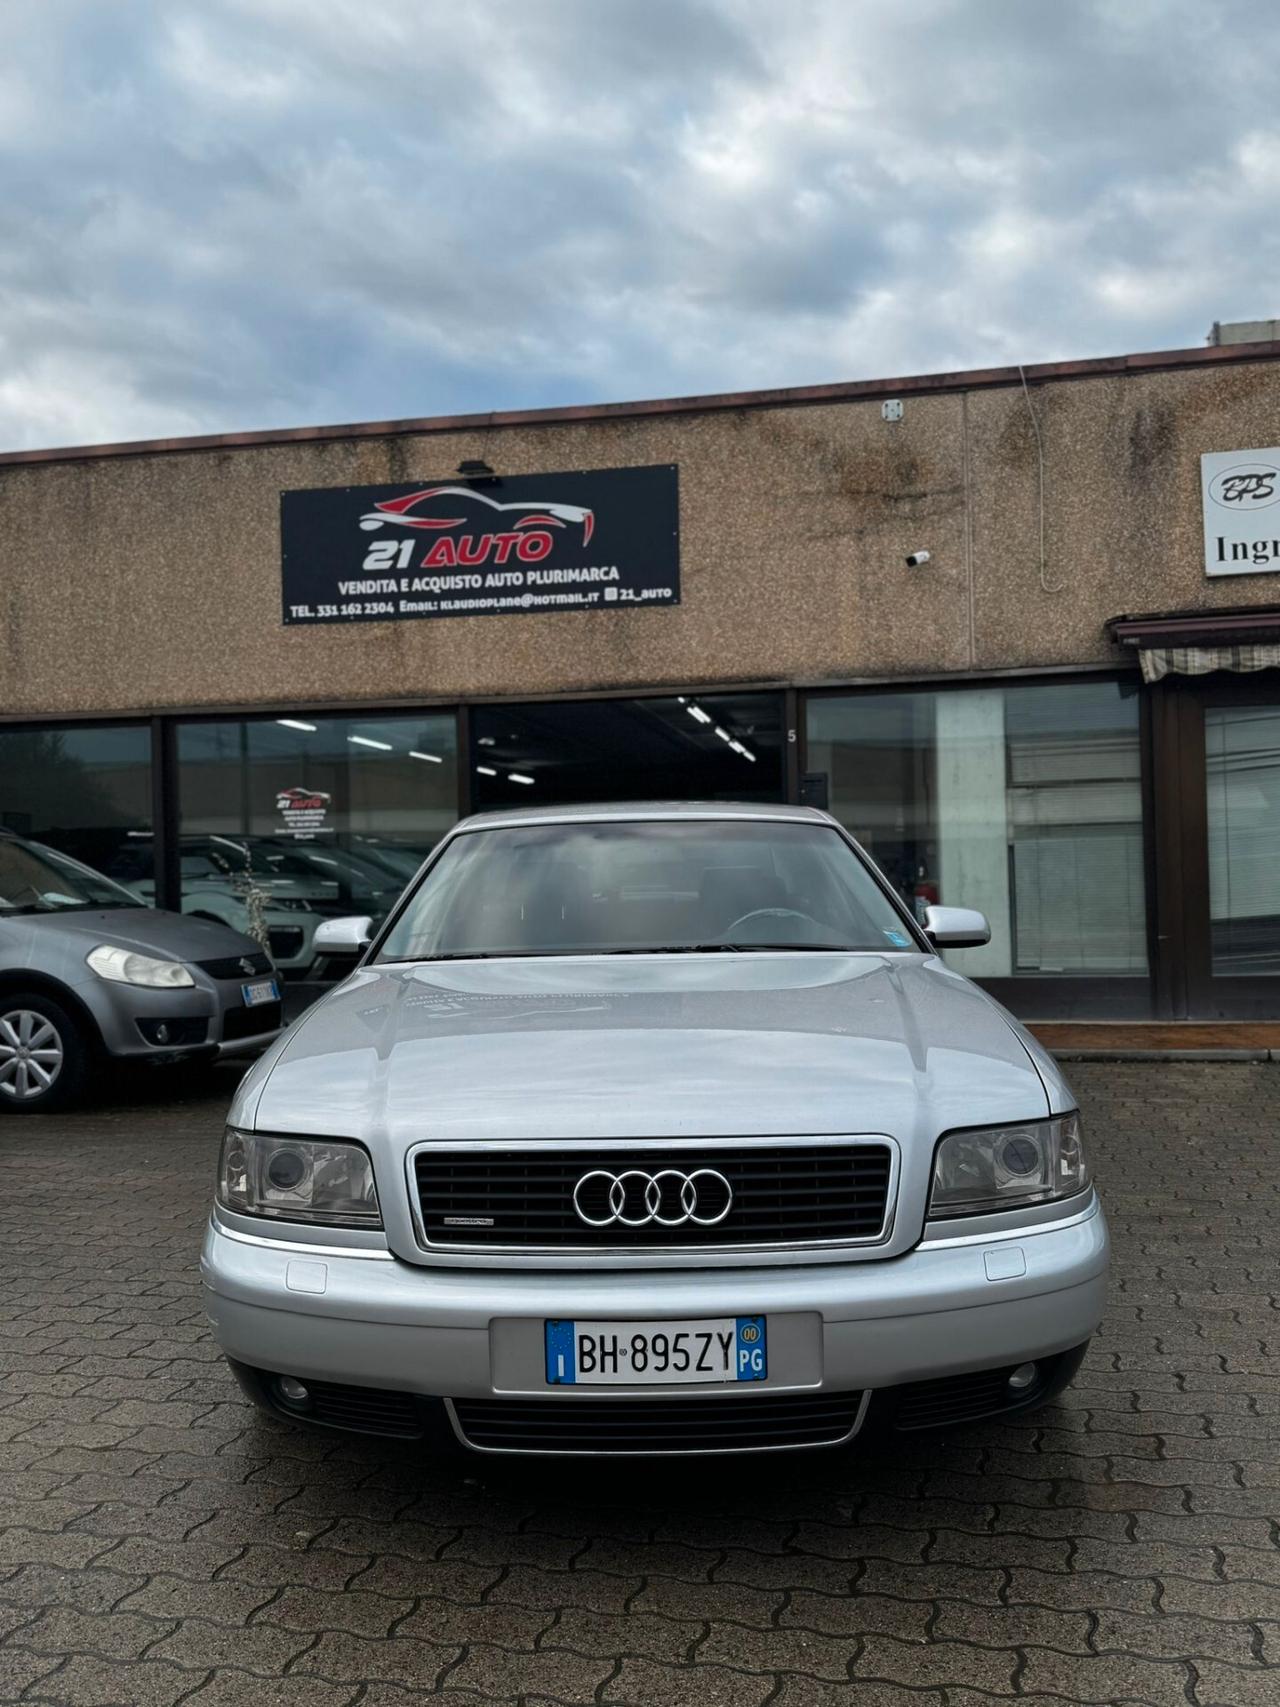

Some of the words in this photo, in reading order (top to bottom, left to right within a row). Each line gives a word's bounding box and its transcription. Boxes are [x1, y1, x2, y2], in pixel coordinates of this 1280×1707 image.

[362, 539, 416, 571] 21
[420, 530, 554, 568] AUTO
[338, 578, 398, 596] VENDITA
[400, 578, 409, 592] E
[411, 573, 482, 594] ACQUISTO
[485, 571, 524, 588] AUTO
[526, 565, 620, 585] PLURIMARCA
[290, 605, 315, 618] TEL.
[317, 604, 339, 617] 331
[340, 603, 362, 616] 162
[364, 602, 394, 615] 2304
[787, 729, 797, 743] 5
[739, 1348, 763, 1372] PG
